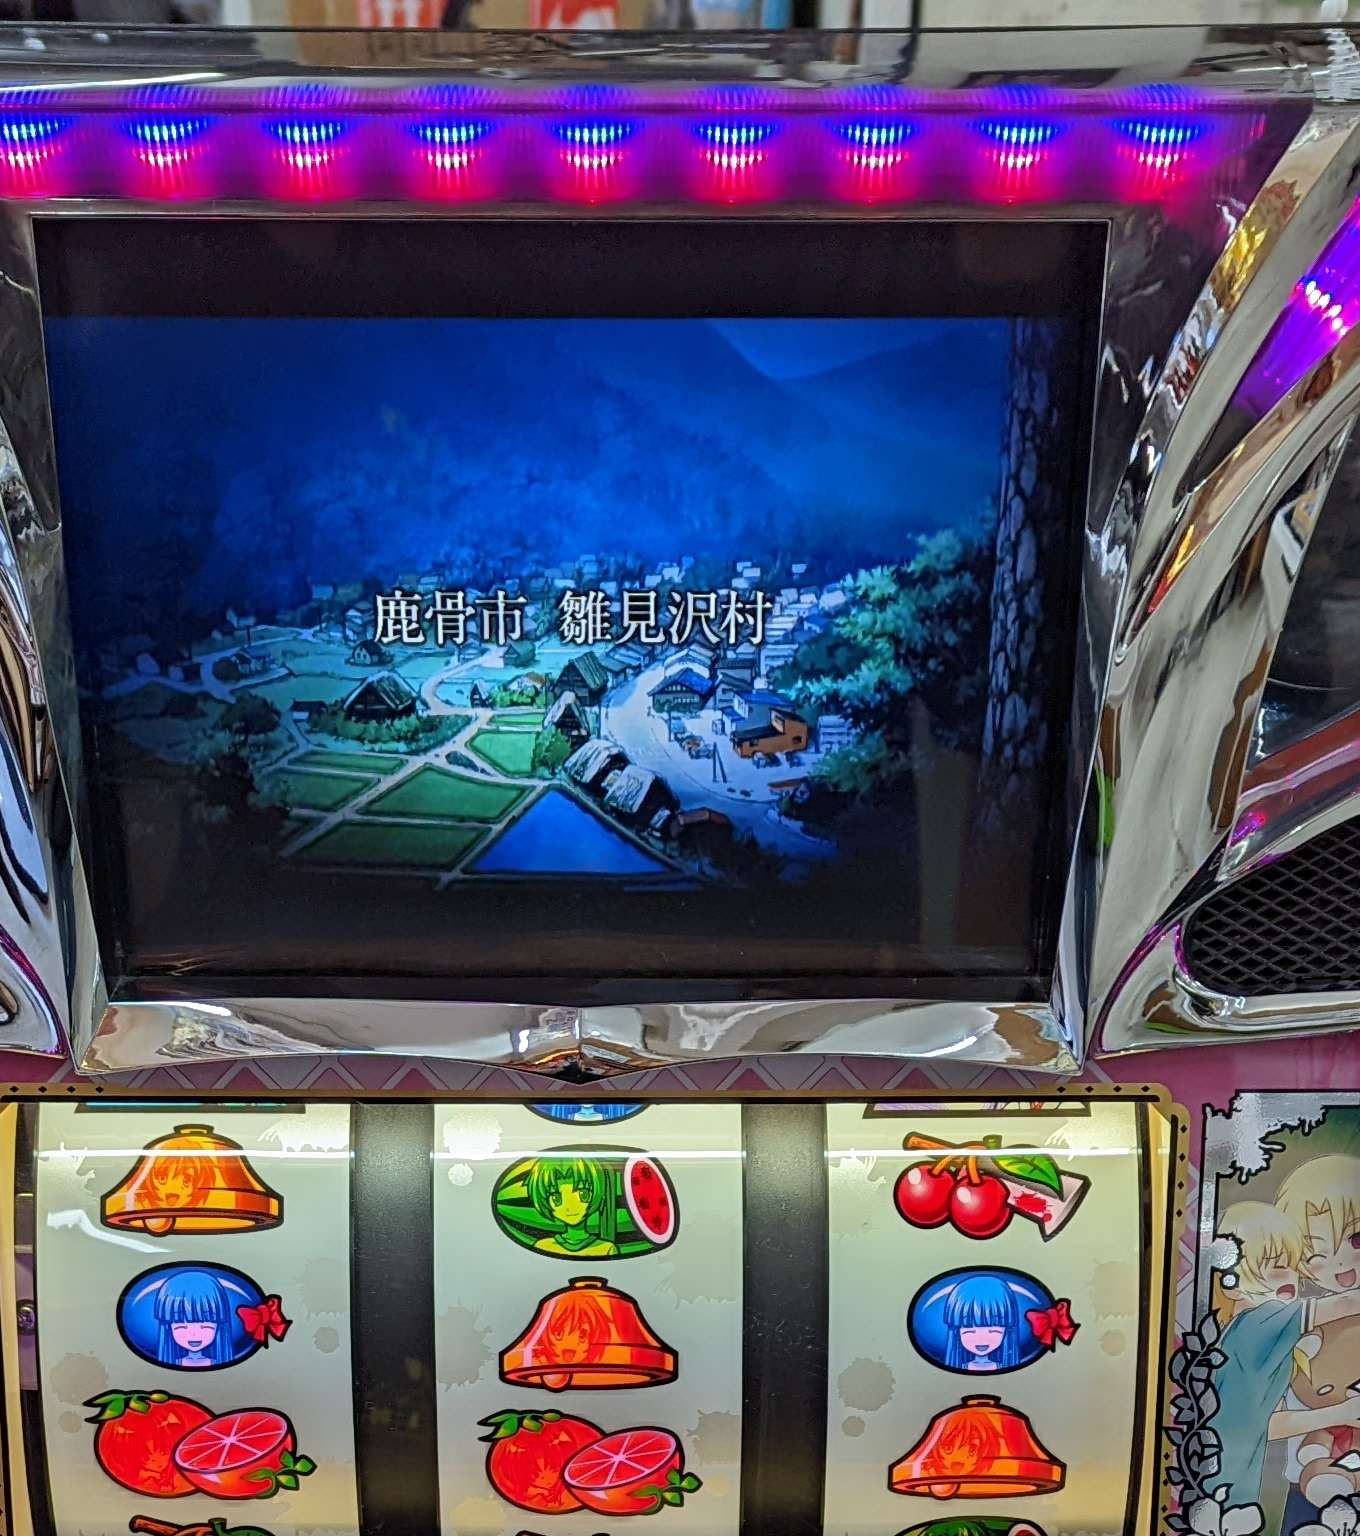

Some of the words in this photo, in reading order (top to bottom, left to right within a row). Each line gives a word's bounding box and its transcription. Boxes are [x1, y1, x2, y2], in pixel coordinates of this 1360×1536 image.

[374, 590, 528, 645] 鹿骨市
[558, 590, 774, 645] 雛見沢村
